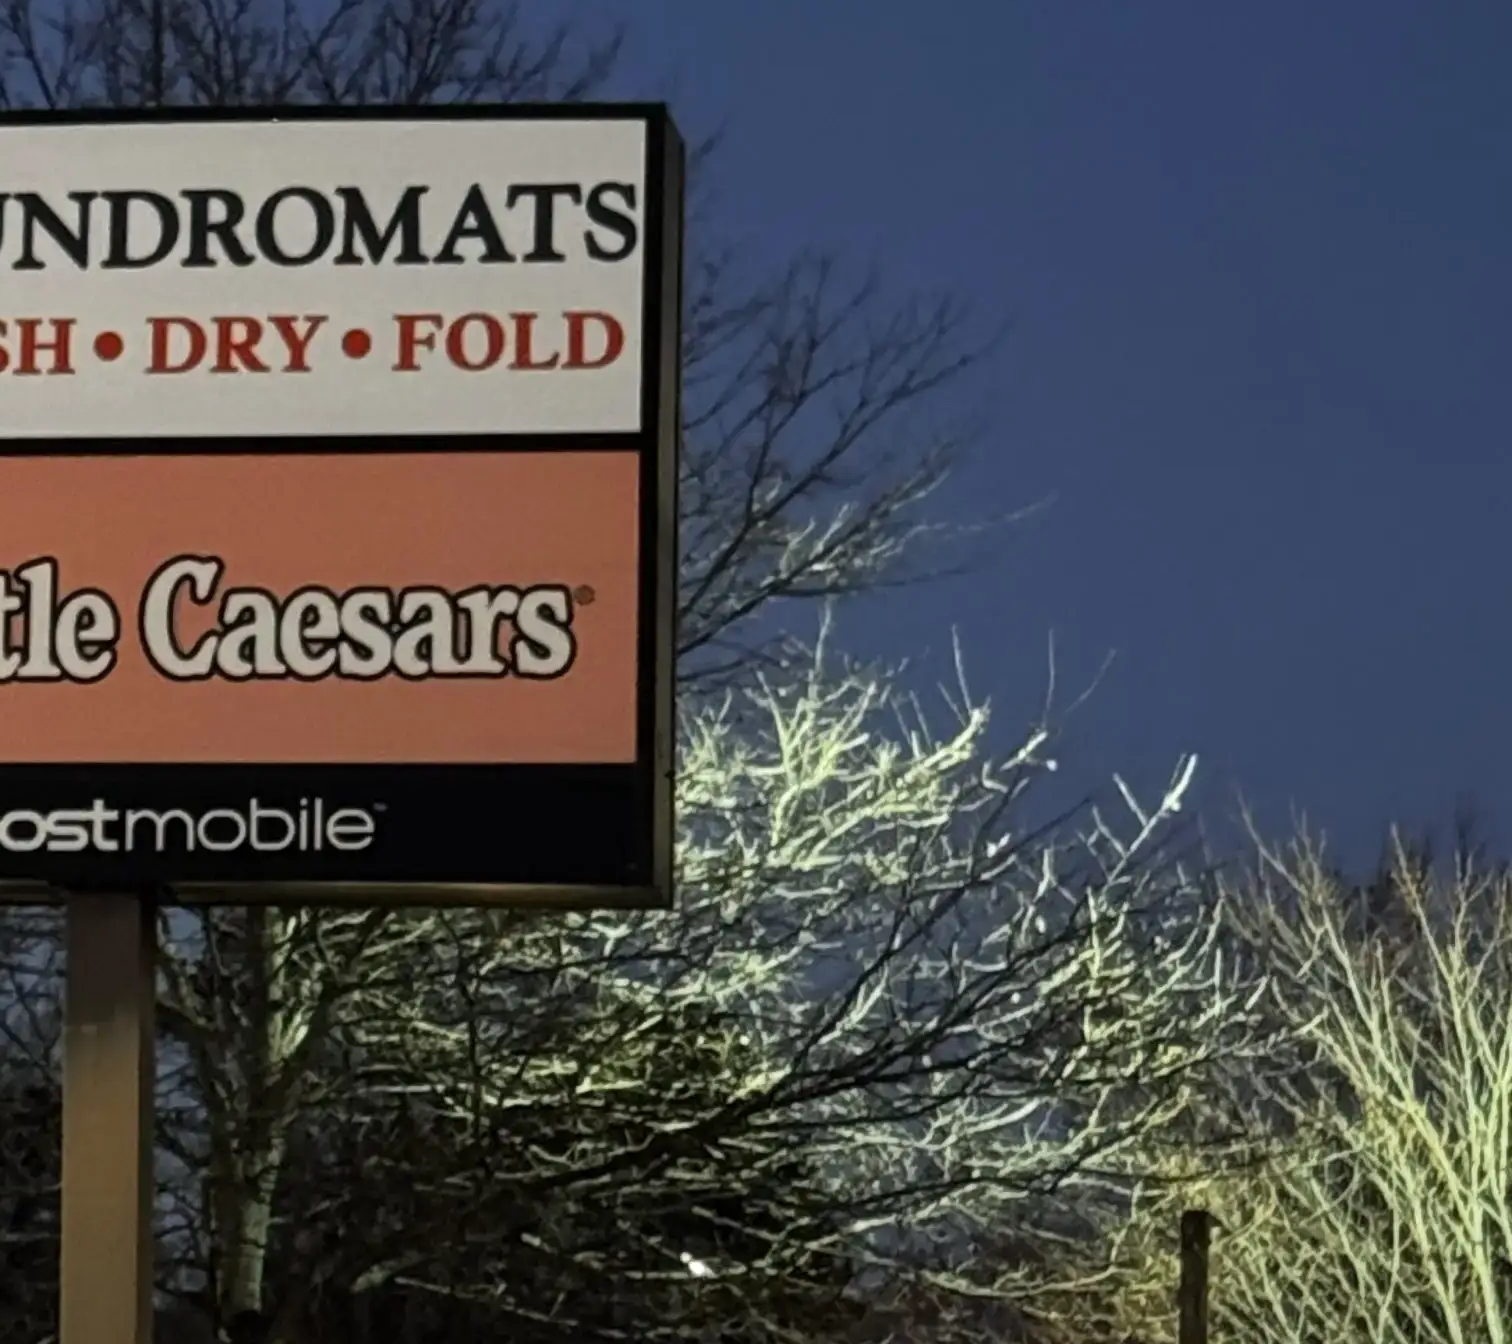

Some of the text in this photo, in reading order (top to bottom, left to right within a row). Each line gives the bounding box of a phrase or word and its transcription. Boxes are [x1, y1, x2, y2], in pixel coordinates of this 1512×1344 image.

[144, 314, 329, 374] DRY
[391, 311, 625, 372] FOLD
[139, 554, 576, 682] Caesars
